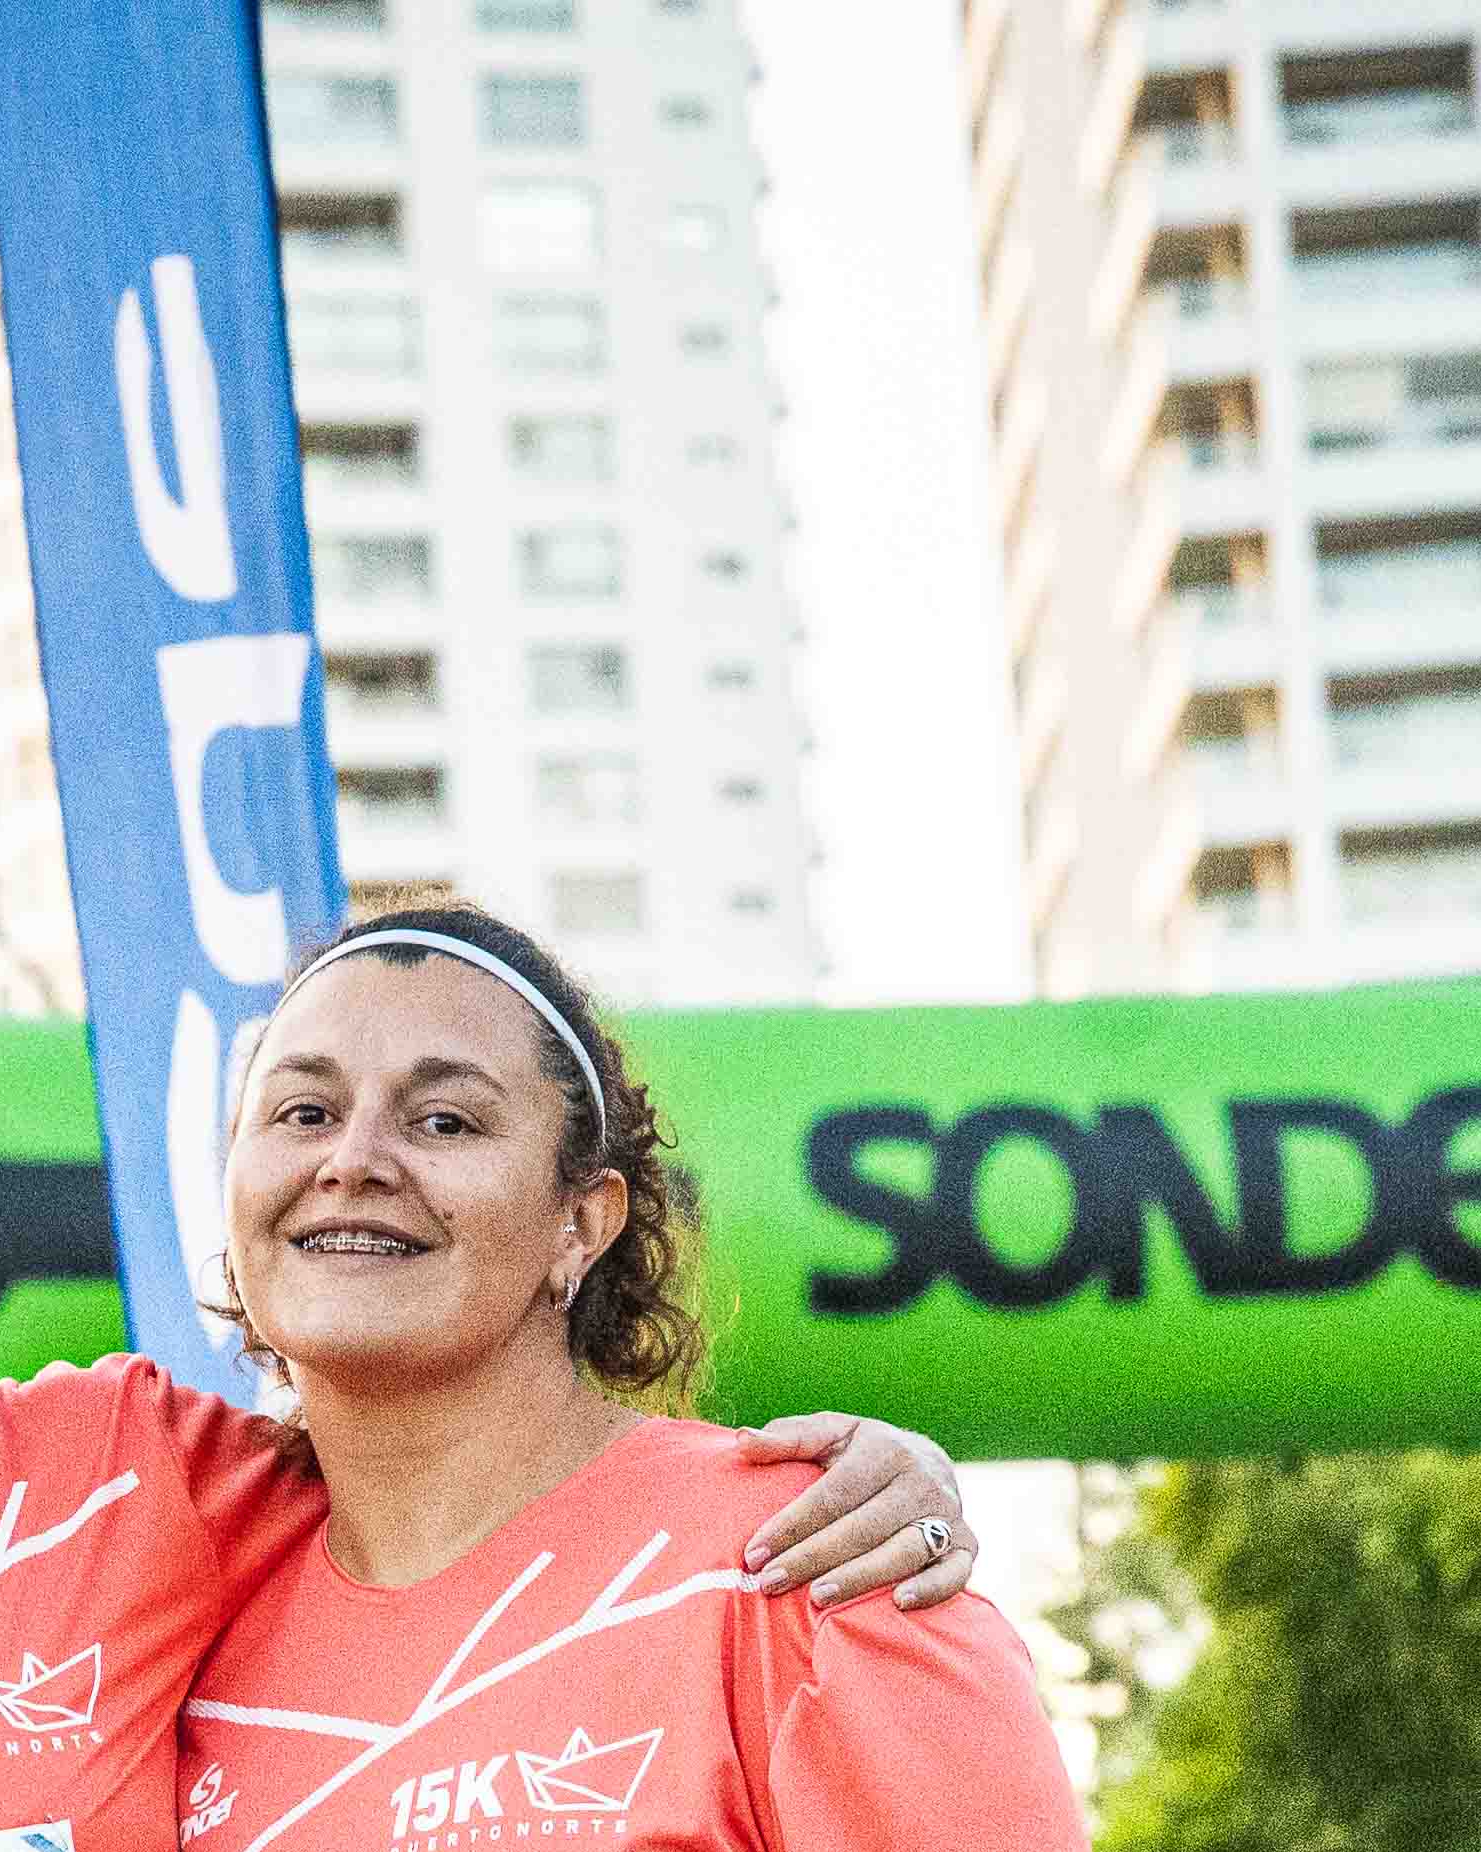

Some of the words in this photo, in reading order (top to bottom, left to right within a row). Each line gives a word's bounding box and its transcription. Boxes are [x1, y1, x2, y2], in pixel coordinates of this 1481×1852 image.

[5, 1729, 105, 1755] NORTE
[390, 1754, 510, 1840] 15K
[515, 1819, 628, 1839] NORTE
